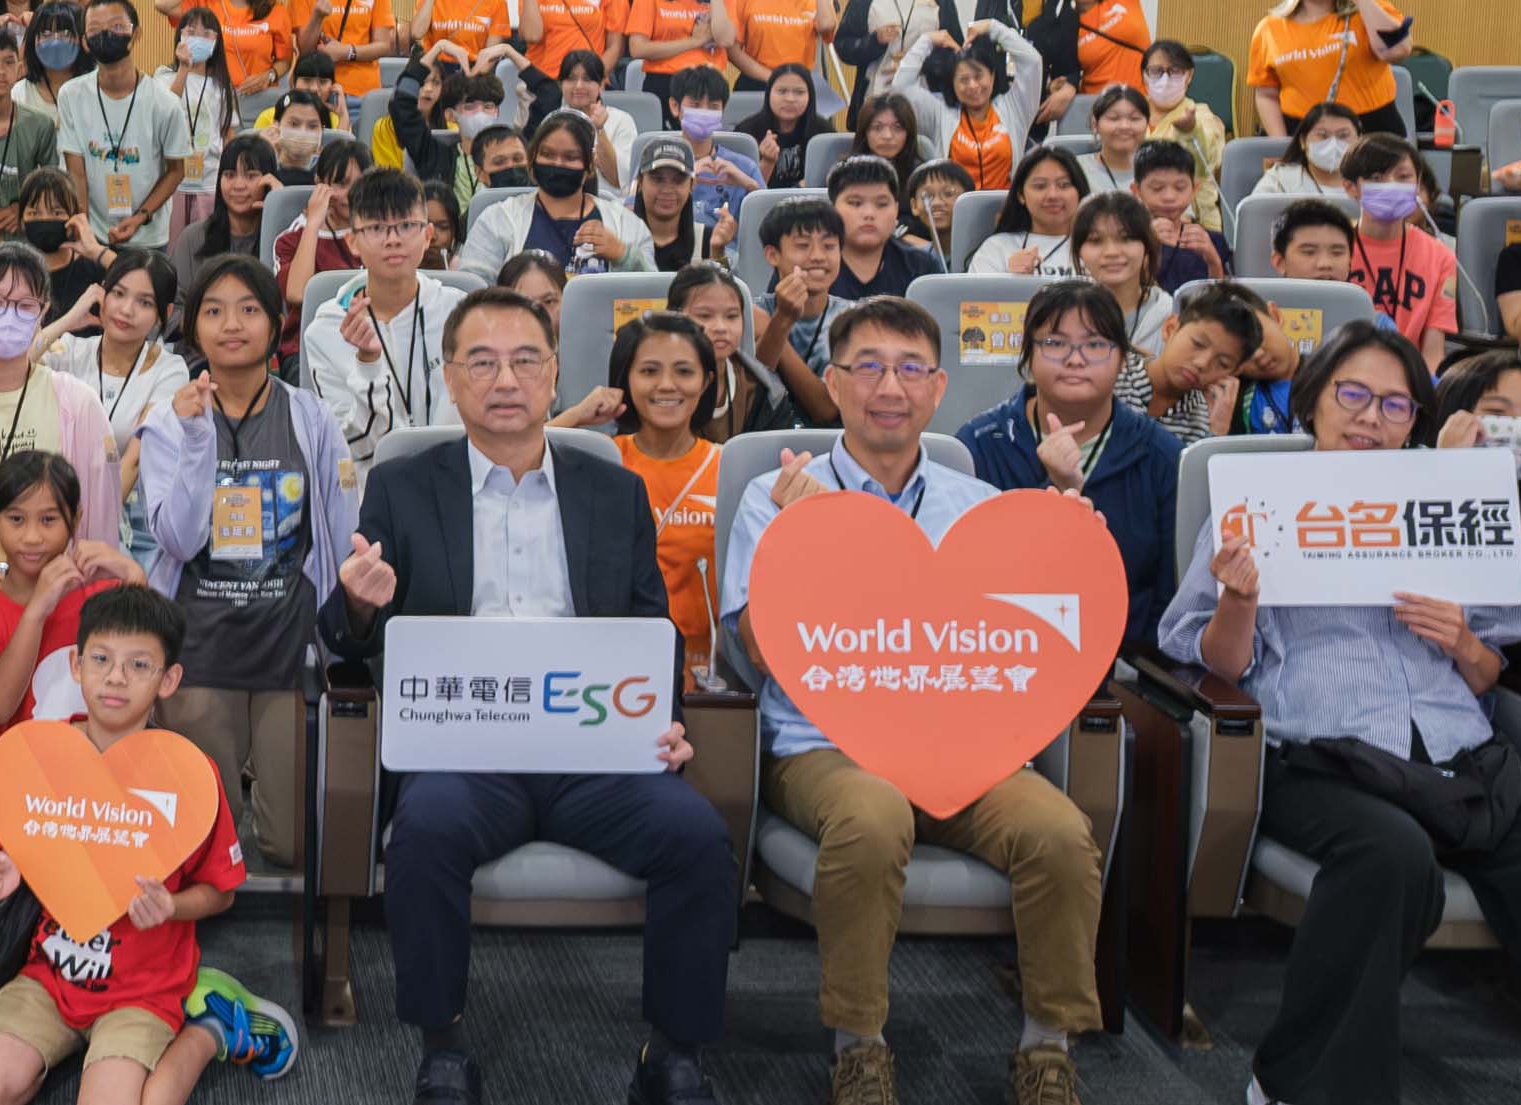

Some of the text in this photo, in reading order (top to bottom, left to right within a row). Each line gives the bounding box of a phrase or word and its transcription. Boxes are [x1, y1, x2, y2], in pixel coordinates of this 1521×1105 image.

[1295, 498, 1515, 548] 台名保經
[1348, 550, 1414, 560] ASSURANCE
[1418, 550, 1463, 559] BROKER
[796, 618, 1038, 654] World Vision
[399, 674, 533, 704] 中華電信
[542, 670, 658, 728] ESG
[399, 707, 531, 724] Chunghwa Telecom
[24, 793, 154, 828] World Vision
